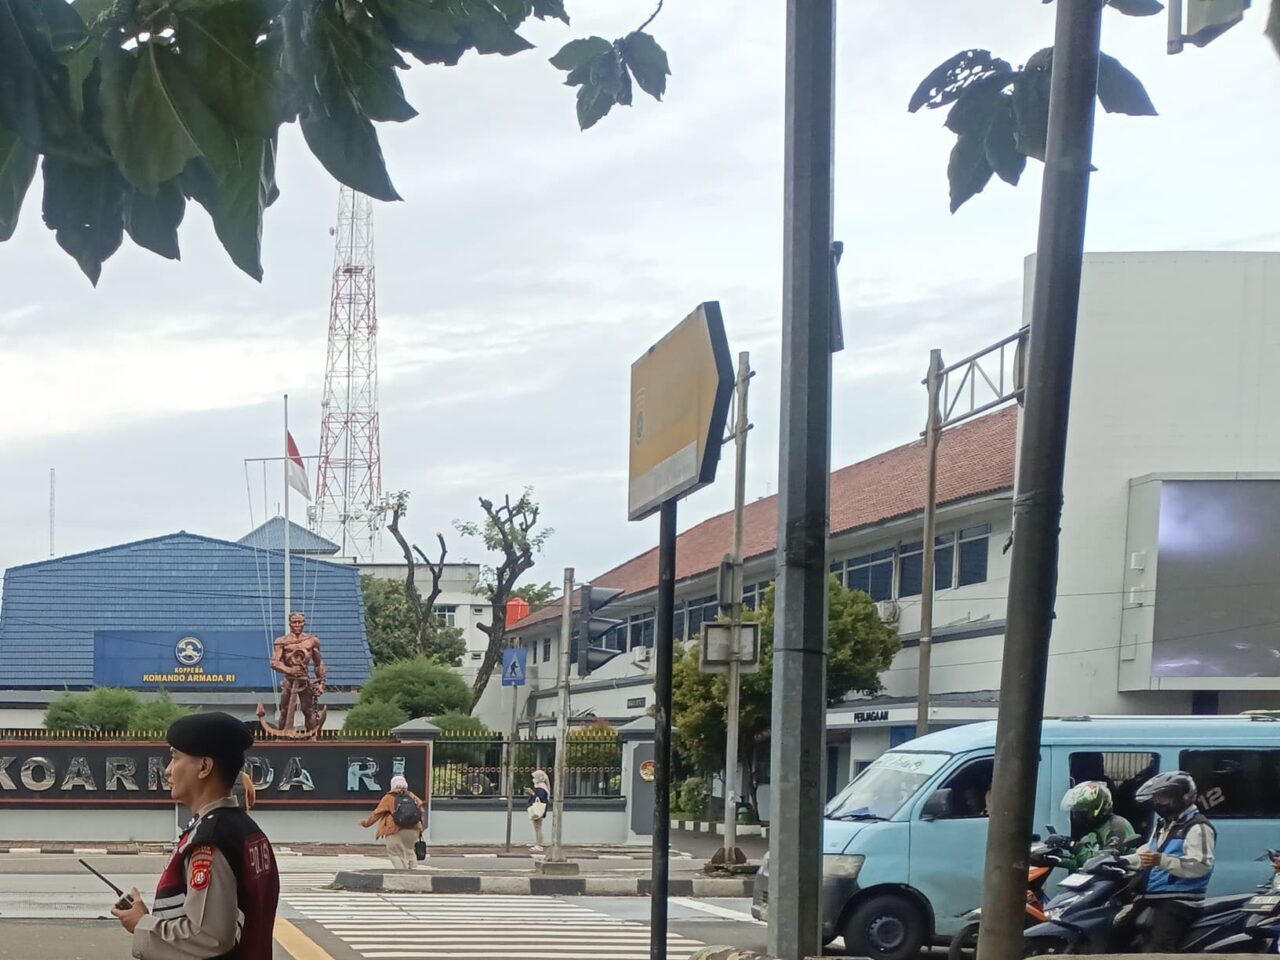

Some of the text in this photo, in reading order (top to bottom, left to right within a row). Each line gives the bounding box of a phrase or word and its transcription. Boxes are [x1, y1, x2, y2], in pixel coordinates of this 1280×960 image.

[143, 674, 235, 682] KOMANDO ARMADA RI
